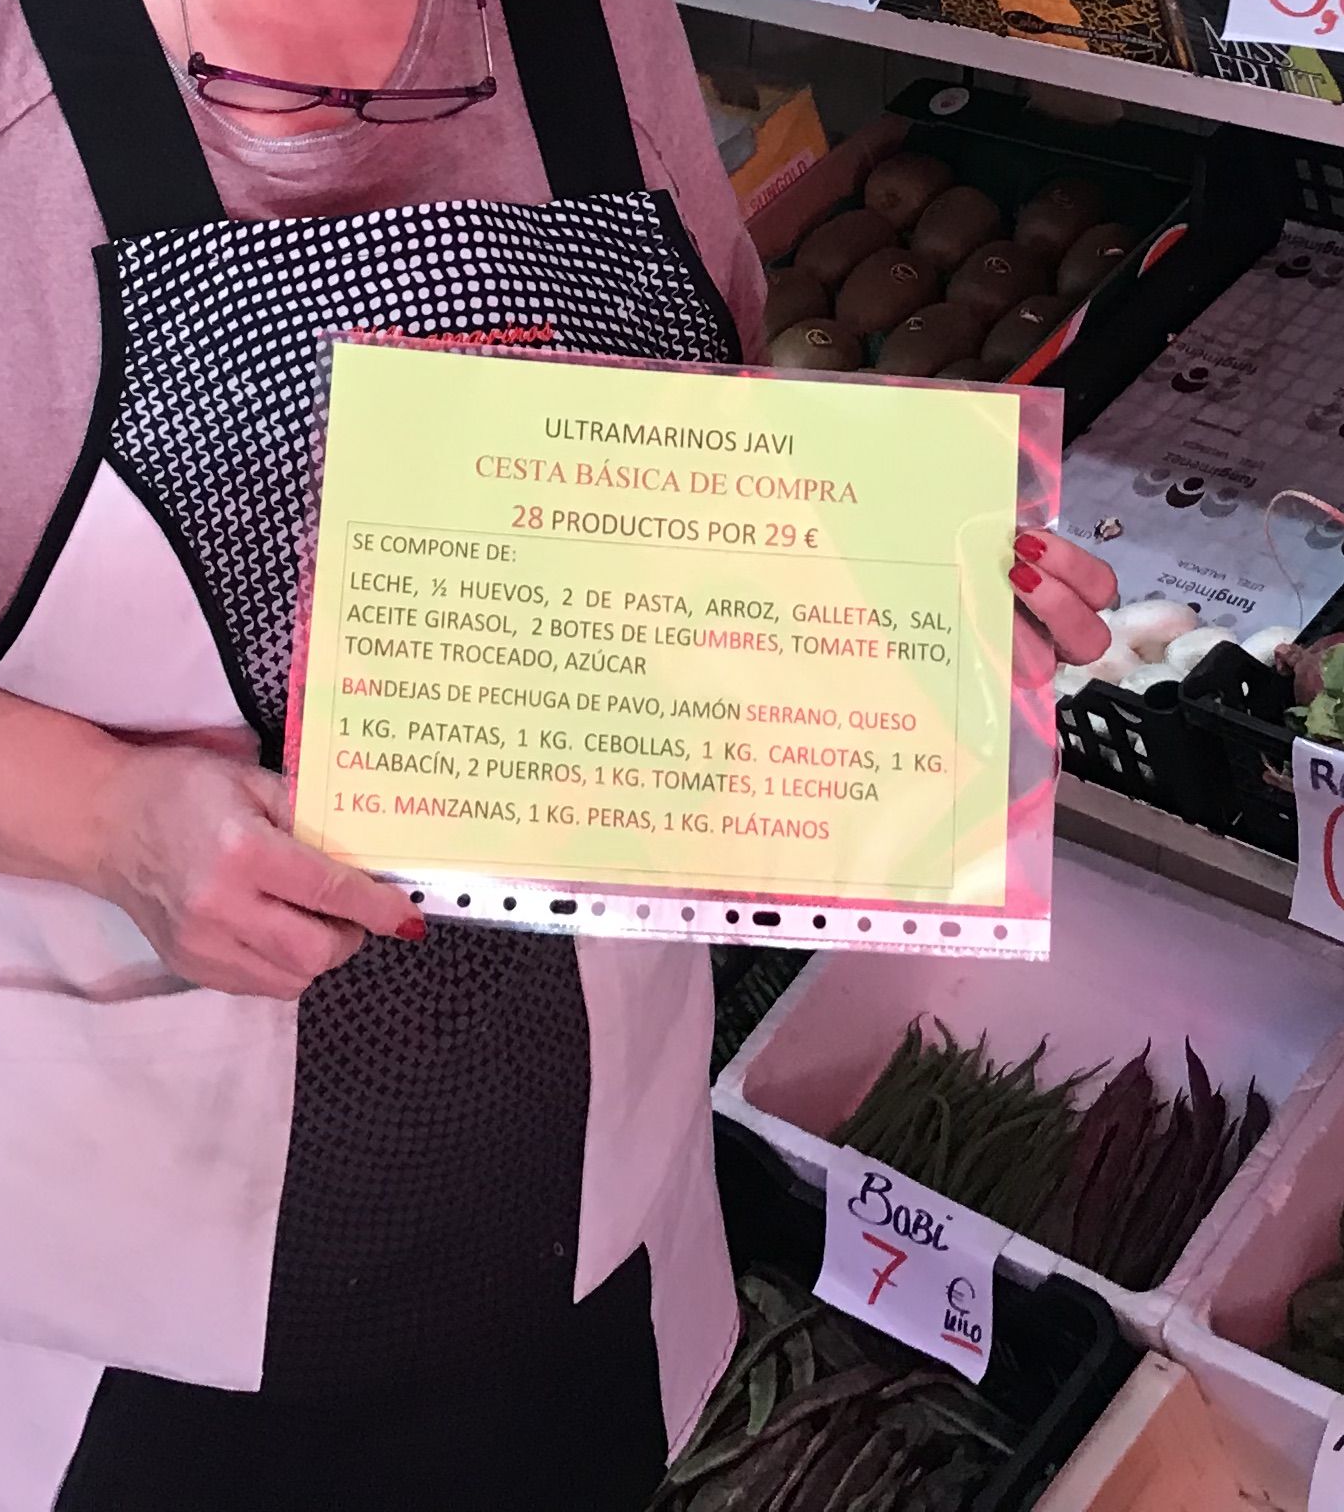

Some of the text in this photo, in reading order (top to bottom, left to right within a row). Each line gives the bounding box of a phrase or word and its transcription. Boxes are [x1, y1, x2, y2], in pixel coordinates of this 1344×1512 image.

[545, 417, 794, 456] ULTRAMARINOS JAVI
[475, 454, 858, 505] CESTA BÁSICA DE COMPRA
[351, 532, 517, 563] SE COMPONE DE:
[511, 504, 819, 549] 28 PRODUCTOS POR 29 €
[1157, 572, 1256, 614] fungiménez
[1178, 560, 1227, 580] VALENCIA
[350, 571, 952, 635] LECHE, ½ HUEVOS, 2 DE PASTA, ARROZ, GALLETAS, SAL,
[344, 635, 647, 676] TOMATE TROCEADO, AZÚCAR
[346, 603, 951, 667] ACEITE GIRASOL, 2 BOTES DE LEGUMBRES, TOMATE FRITO,
[341, 676, 917, 732] BANDEJAS DE PECHUGA DE PAVO, JAMÓN SERRANO, QUESO
[339, 716, 948, 774] 1 KG. PATATAS, 1 KG. CEBOLLAS, 1 KG. CARLOTAS, 1 KG.
[335, 749, 880, 802] CALABACÍN, 2 PUERROS, 1 KG. TOMATES, 1 LECHUGA
[333, 791, 830, 840] 1 KG. MANZANAS, 1 KG. PERAS, 1 KG. PLÁTANOS
[861, 1230, 976, 1315] 7 €
